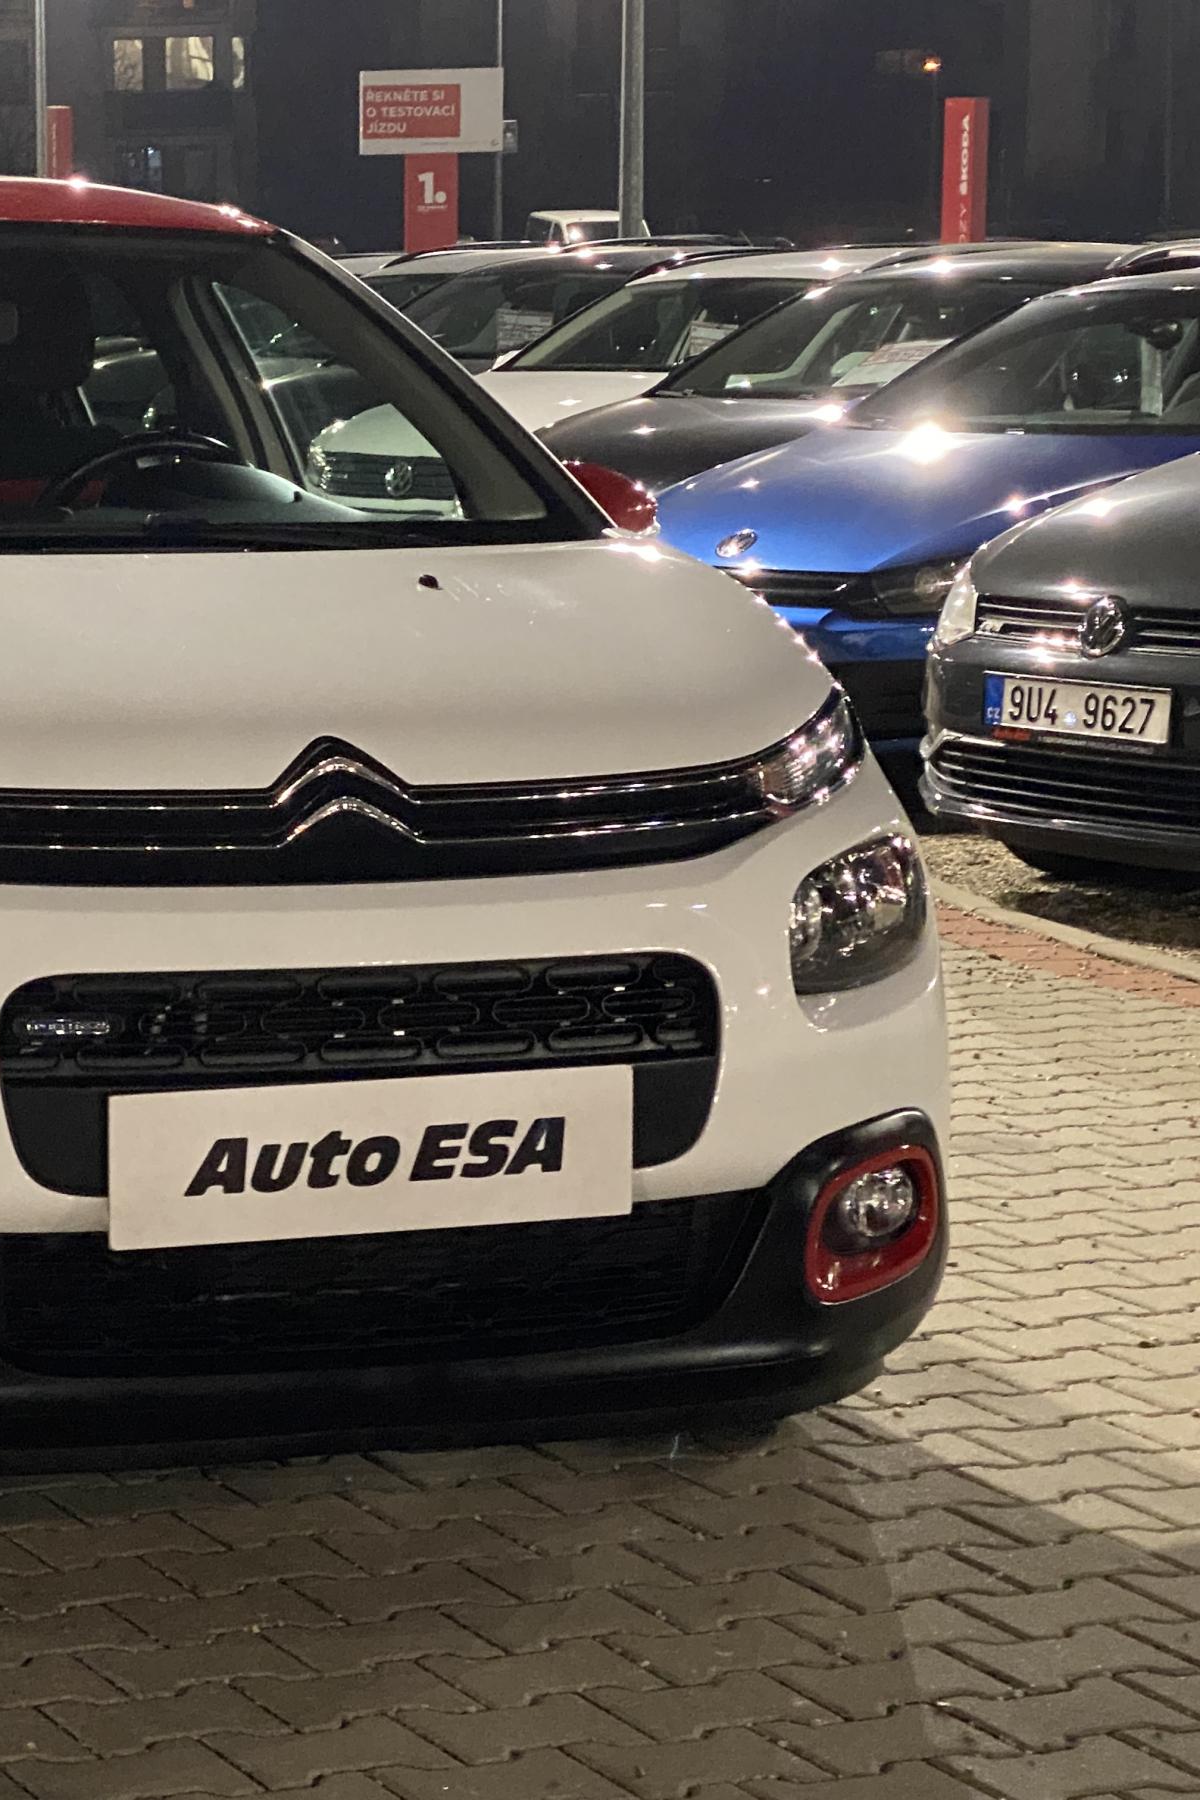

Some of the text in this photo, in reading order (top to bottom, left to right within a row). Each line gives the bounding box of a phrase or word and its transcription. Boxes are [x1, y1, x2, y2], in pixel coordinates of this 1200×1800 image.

[366, 89, 445, 102] ŘEKNĚTE SI
[366, 104, 455, 118] O TESTOVACÍ
[366, 120, 407, 134] JÍZDU
[417, 171, 447, 204] 1.
[986, 685, 1156, 735] CZ 9U4 9627
[184, 1116, 566, 1197] Auto ESA
